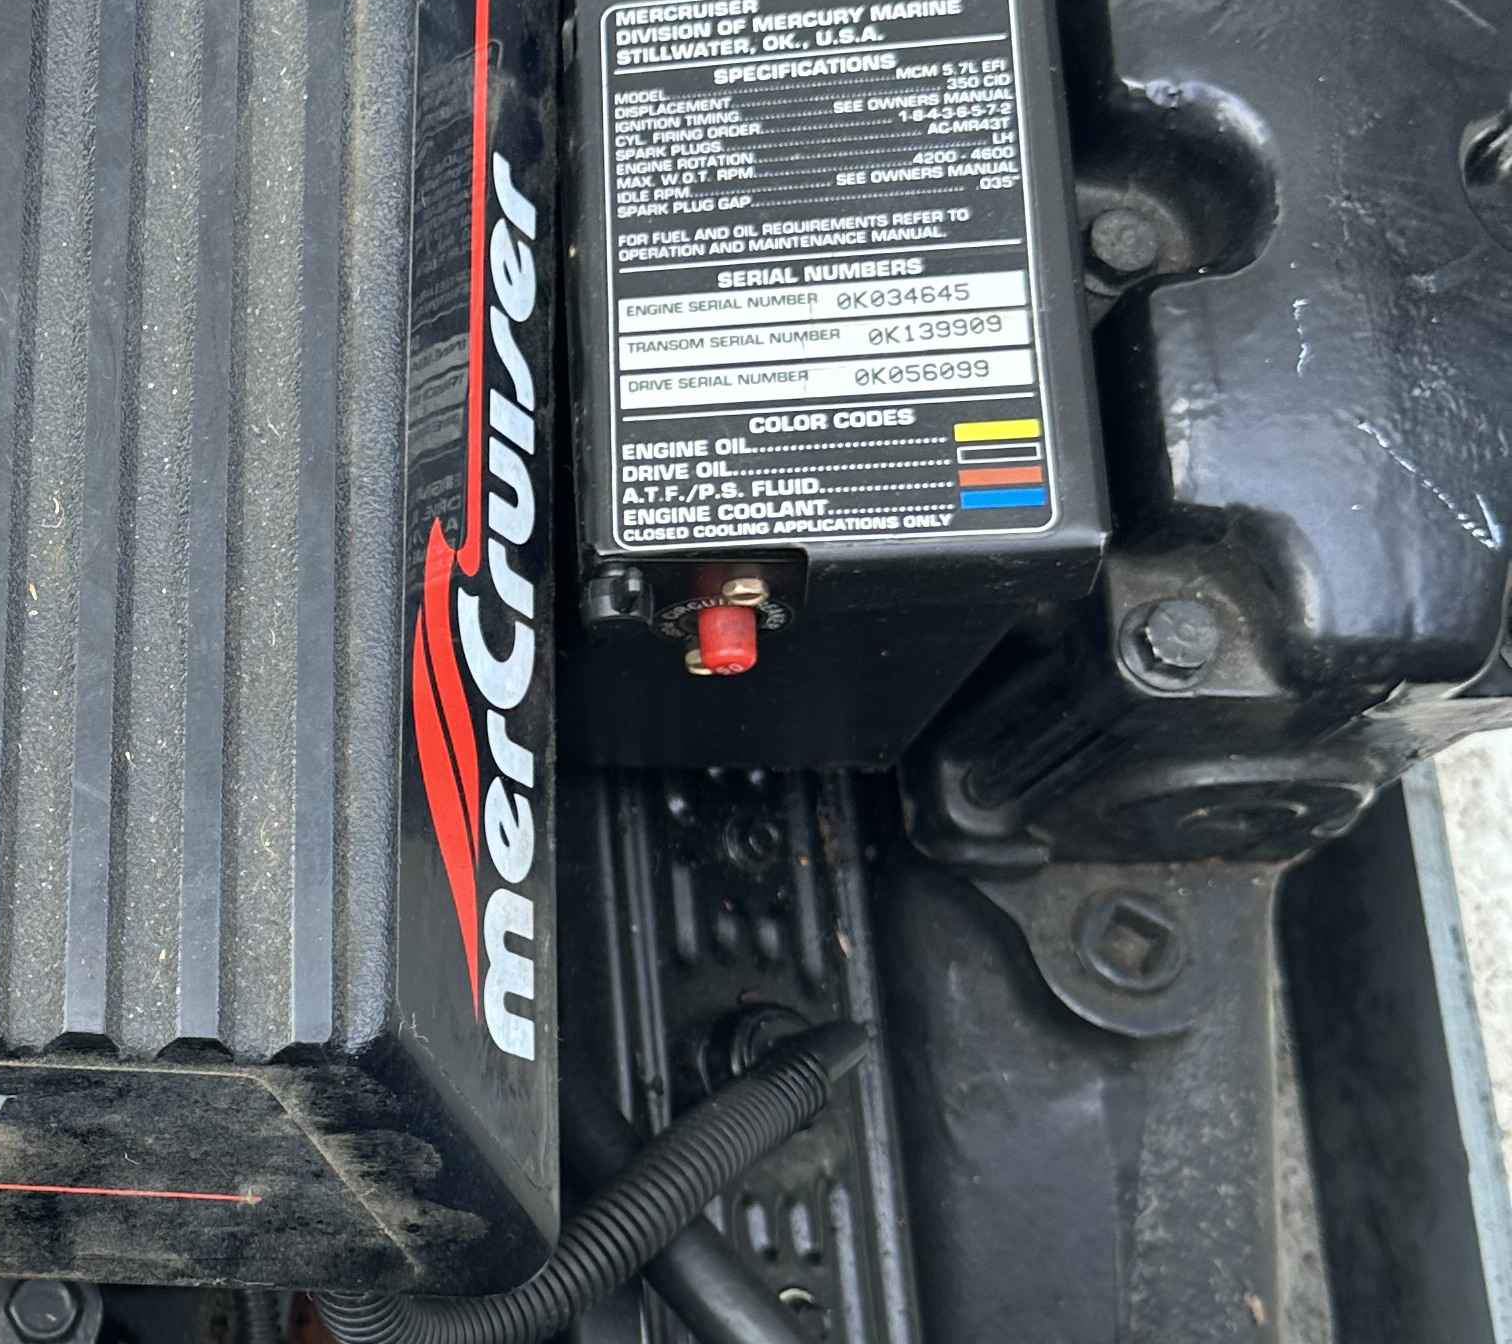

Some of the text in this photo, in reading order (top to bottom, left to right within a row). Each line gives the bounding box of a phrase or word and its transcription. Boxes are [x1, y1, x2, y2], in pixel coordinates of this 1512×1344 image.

[616, 22, 712, 46] DIVISION
[717, 19, 746, 35] OF
[752, 7, 865, 32] MERCURY
[617, 38, 757, 65] STILLWATER,
[816, 25, 885, 46] U.S.A.
[615, 58, 1007, 104] MODEL MCM 5.7L EFI
[714, 53, 897, 84] SPECIFICATIONS
[615, 73, 1013, 119] DISPLACEMENT 350 CID
[615, 88, 1013, 133] IGNITION TIMING SEE OWNERS MANUAL
[653, 127, 704, 144] FIRING
[707, 123, 761, 137] ORDER
[899, 102, 1012, 122] 1-8-4-3-6-5-7-2
[616, 146, 666, 161] SPARK
[671, 141, 721, 156] PLUGS
[616, 131, 1015, 175] ENGINE ROTATION LH
[716, 166, 754, 181] RPM
[913, 150, 956, 164] 4200
[970, 146, 1014, 159] 4600
[617, 161, 1018, 204] IDLE RPM SEE OWNERS MANUAL
[617, 204, 668, 218] SPARK
[673, 199, 714, 214] PLUG
[718, 196, 752, 210] GAP
[618, 208, 970, 247] FOR FUEL AND OIL REQUIREMENTS REFER TO
[619, 226, 947, 262] OPERATION AND MAINTENANCE MANUAL.
[718, 257, 924, 288] SERIAL NUMBERS
[627, 283, 970, 316] ENGINE SERIAL NUMBER 0K034645
[627, 314, 1002, 354] TRANSOM SERIAL NUMBER 0K139909
[628, 359, 990, 392] DRIVE SERIAL NUMBER 0K056099
[749, 408, 916, 433] COLOR CODES
[622, 437, 749, 460] ENGINE OIL
[622, 460, 731, 482] DRIVE OIL
[622, 478, 819, 504] A.T.F./P.S. FLUID
[623, 499, 828, 525] ENGINE COOLANT
[623, 513, 952, 541] CLOSED COOLING APPLICATIONS ONLY
[456, 150, 540, 1061] merCruiser
